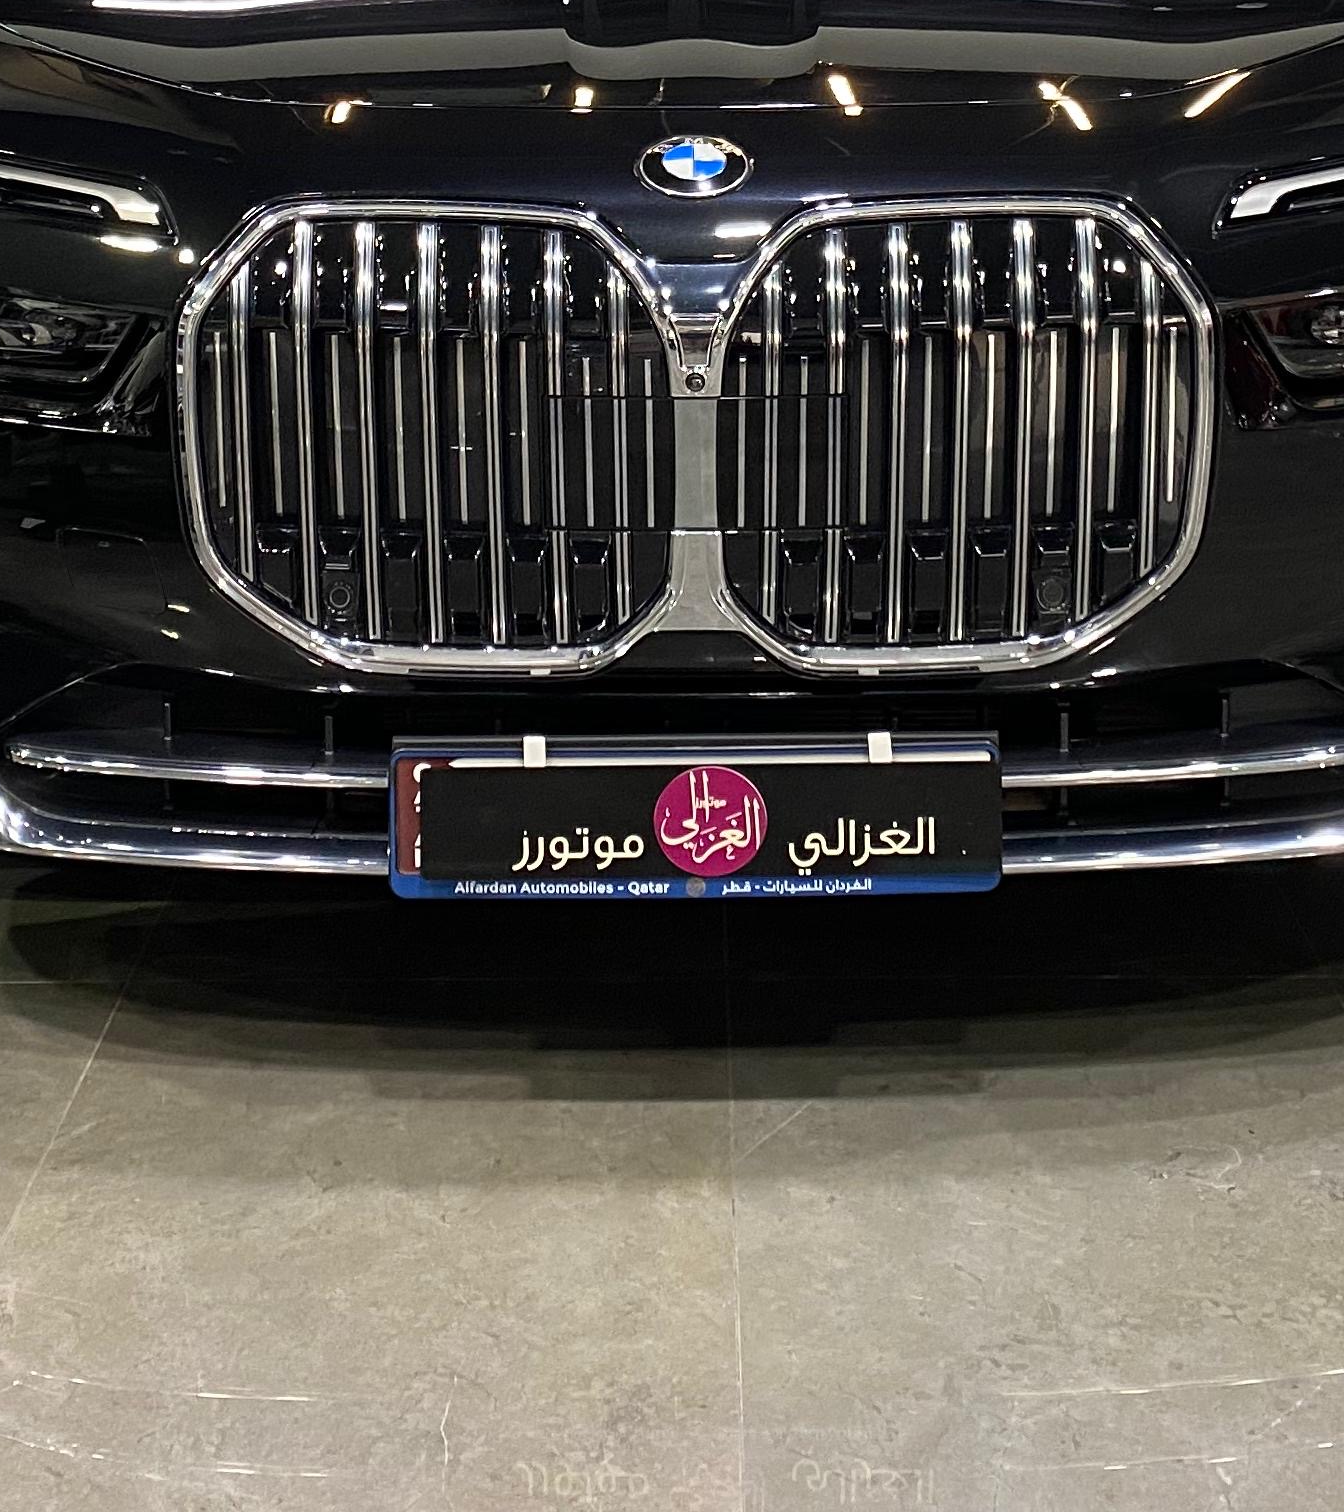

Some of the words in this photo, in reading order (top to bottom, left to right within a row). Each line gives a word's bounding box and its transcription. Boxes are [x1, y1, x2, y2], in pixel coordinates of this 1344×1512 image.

[511, 827, 645, 872] موتورز
[788, 816, 935, 876] الغزالي
[454, 881, 516, 895] Alfardan
[520, 881, 614, 895] Automobiles
[627, 880, 670, 896] Qatar
[721, 879, 752, 895] قطر
[762, 879, 823, 895] للسيارات
[825, 878, 872, 894] الفردان
